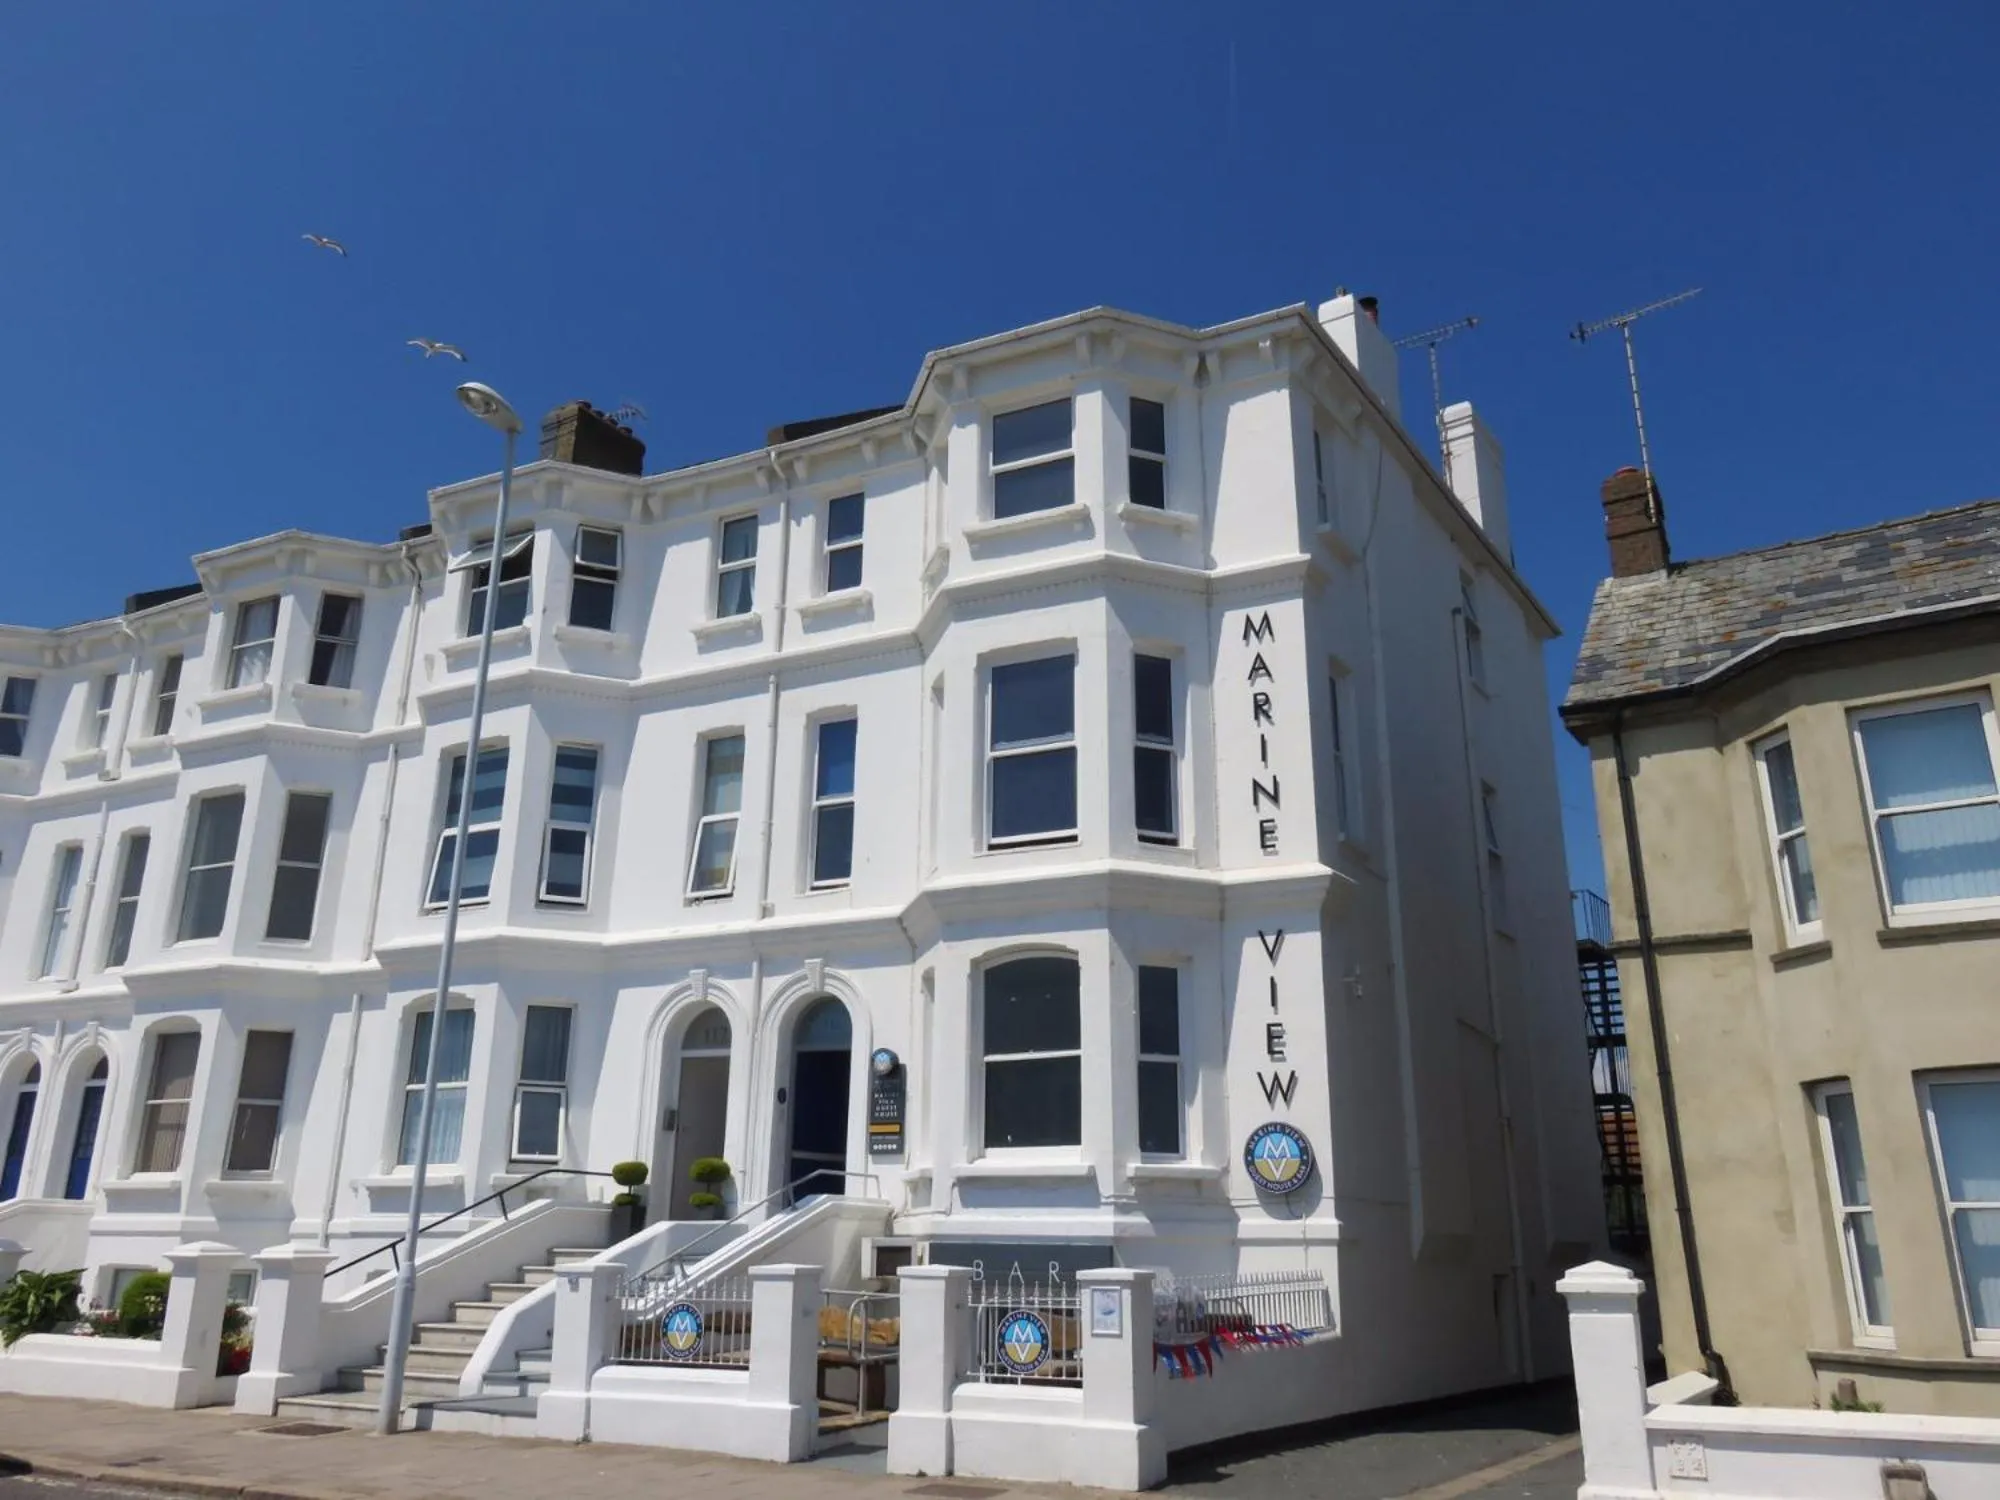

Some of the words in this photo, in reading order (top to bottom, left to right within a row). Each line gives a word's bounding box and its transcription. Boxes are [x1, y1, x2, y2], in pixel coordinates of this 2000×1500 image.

[1242, 610, 1279, 850] MARINE
[1257, 929, 1297, 1103] VIEW
[1249, 1124, 1281, 1149] MARINE
[1284, 1126, 1306, 1147] VIEW
[972, 1259, 1061, 1284] BAR
